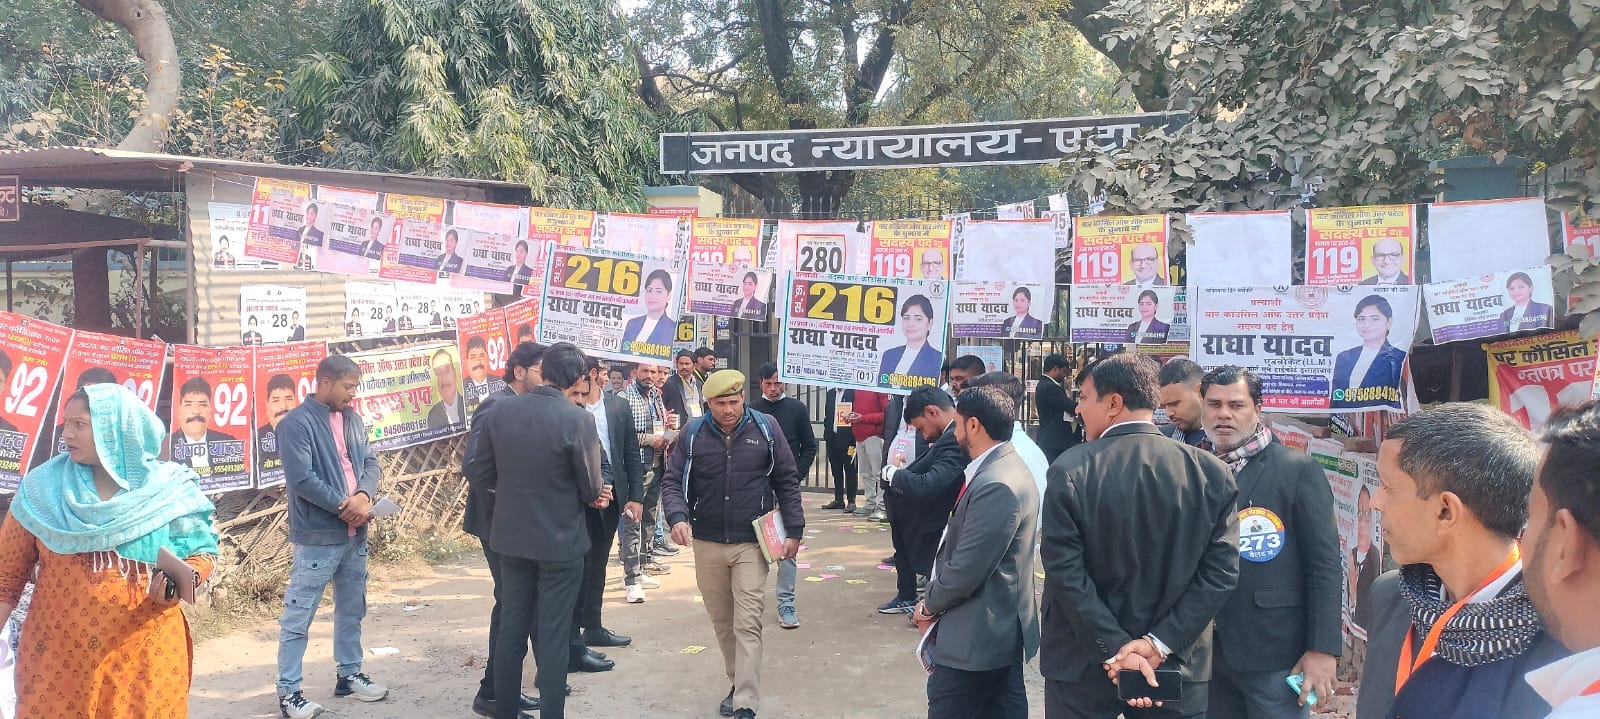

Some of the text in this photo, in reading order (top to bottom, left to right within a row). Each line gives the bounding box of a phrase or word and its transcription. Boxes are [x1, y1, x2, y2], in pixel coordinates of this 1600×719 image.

[691, 138, 794, 167] जनपद
[800, 246, 843, 274] 280
[872, 253, 911, 278] 119
[1077, 251, 1118, 278] 119
[1312, 246, 1359, 275] 119
[565, 254, 640, 296] 216
[715, 285, 740, 296] यादव
[370, 307, 383, 320] 28
[417, 302, 429, 313] 28
[459, 303, 472, 315] 28
[547, 296, 580, 315] राधा
[582, 300, 625, 321] यादव
[807, 282, 896, 324] 216
[955, 303, 1009, 313] राधा यादव
[1075, 307, 1134, 318] राधा यादव
[1431, 295, 1503, 316] राधा यादव
[272, 314, 288, 327] 28
[543, 330, 557, 340] 216
[789, 327, 880, 351] राधा यादव
[1200, 334, 1256, 356] राधा
[1261, 335, 1334, 356] यादव
[487, 336, 507, 371] 92
[786, 364, 801, 375] 216
[856, 370, 874, 383] (01)
[1568, 360, 1594, 377] पर
[5, 363, 48, 417] 92
[213, 382, 248, 428] 92
[209, 440, 246, 456] यादव
[1239, 533, 1281, 552] 273
